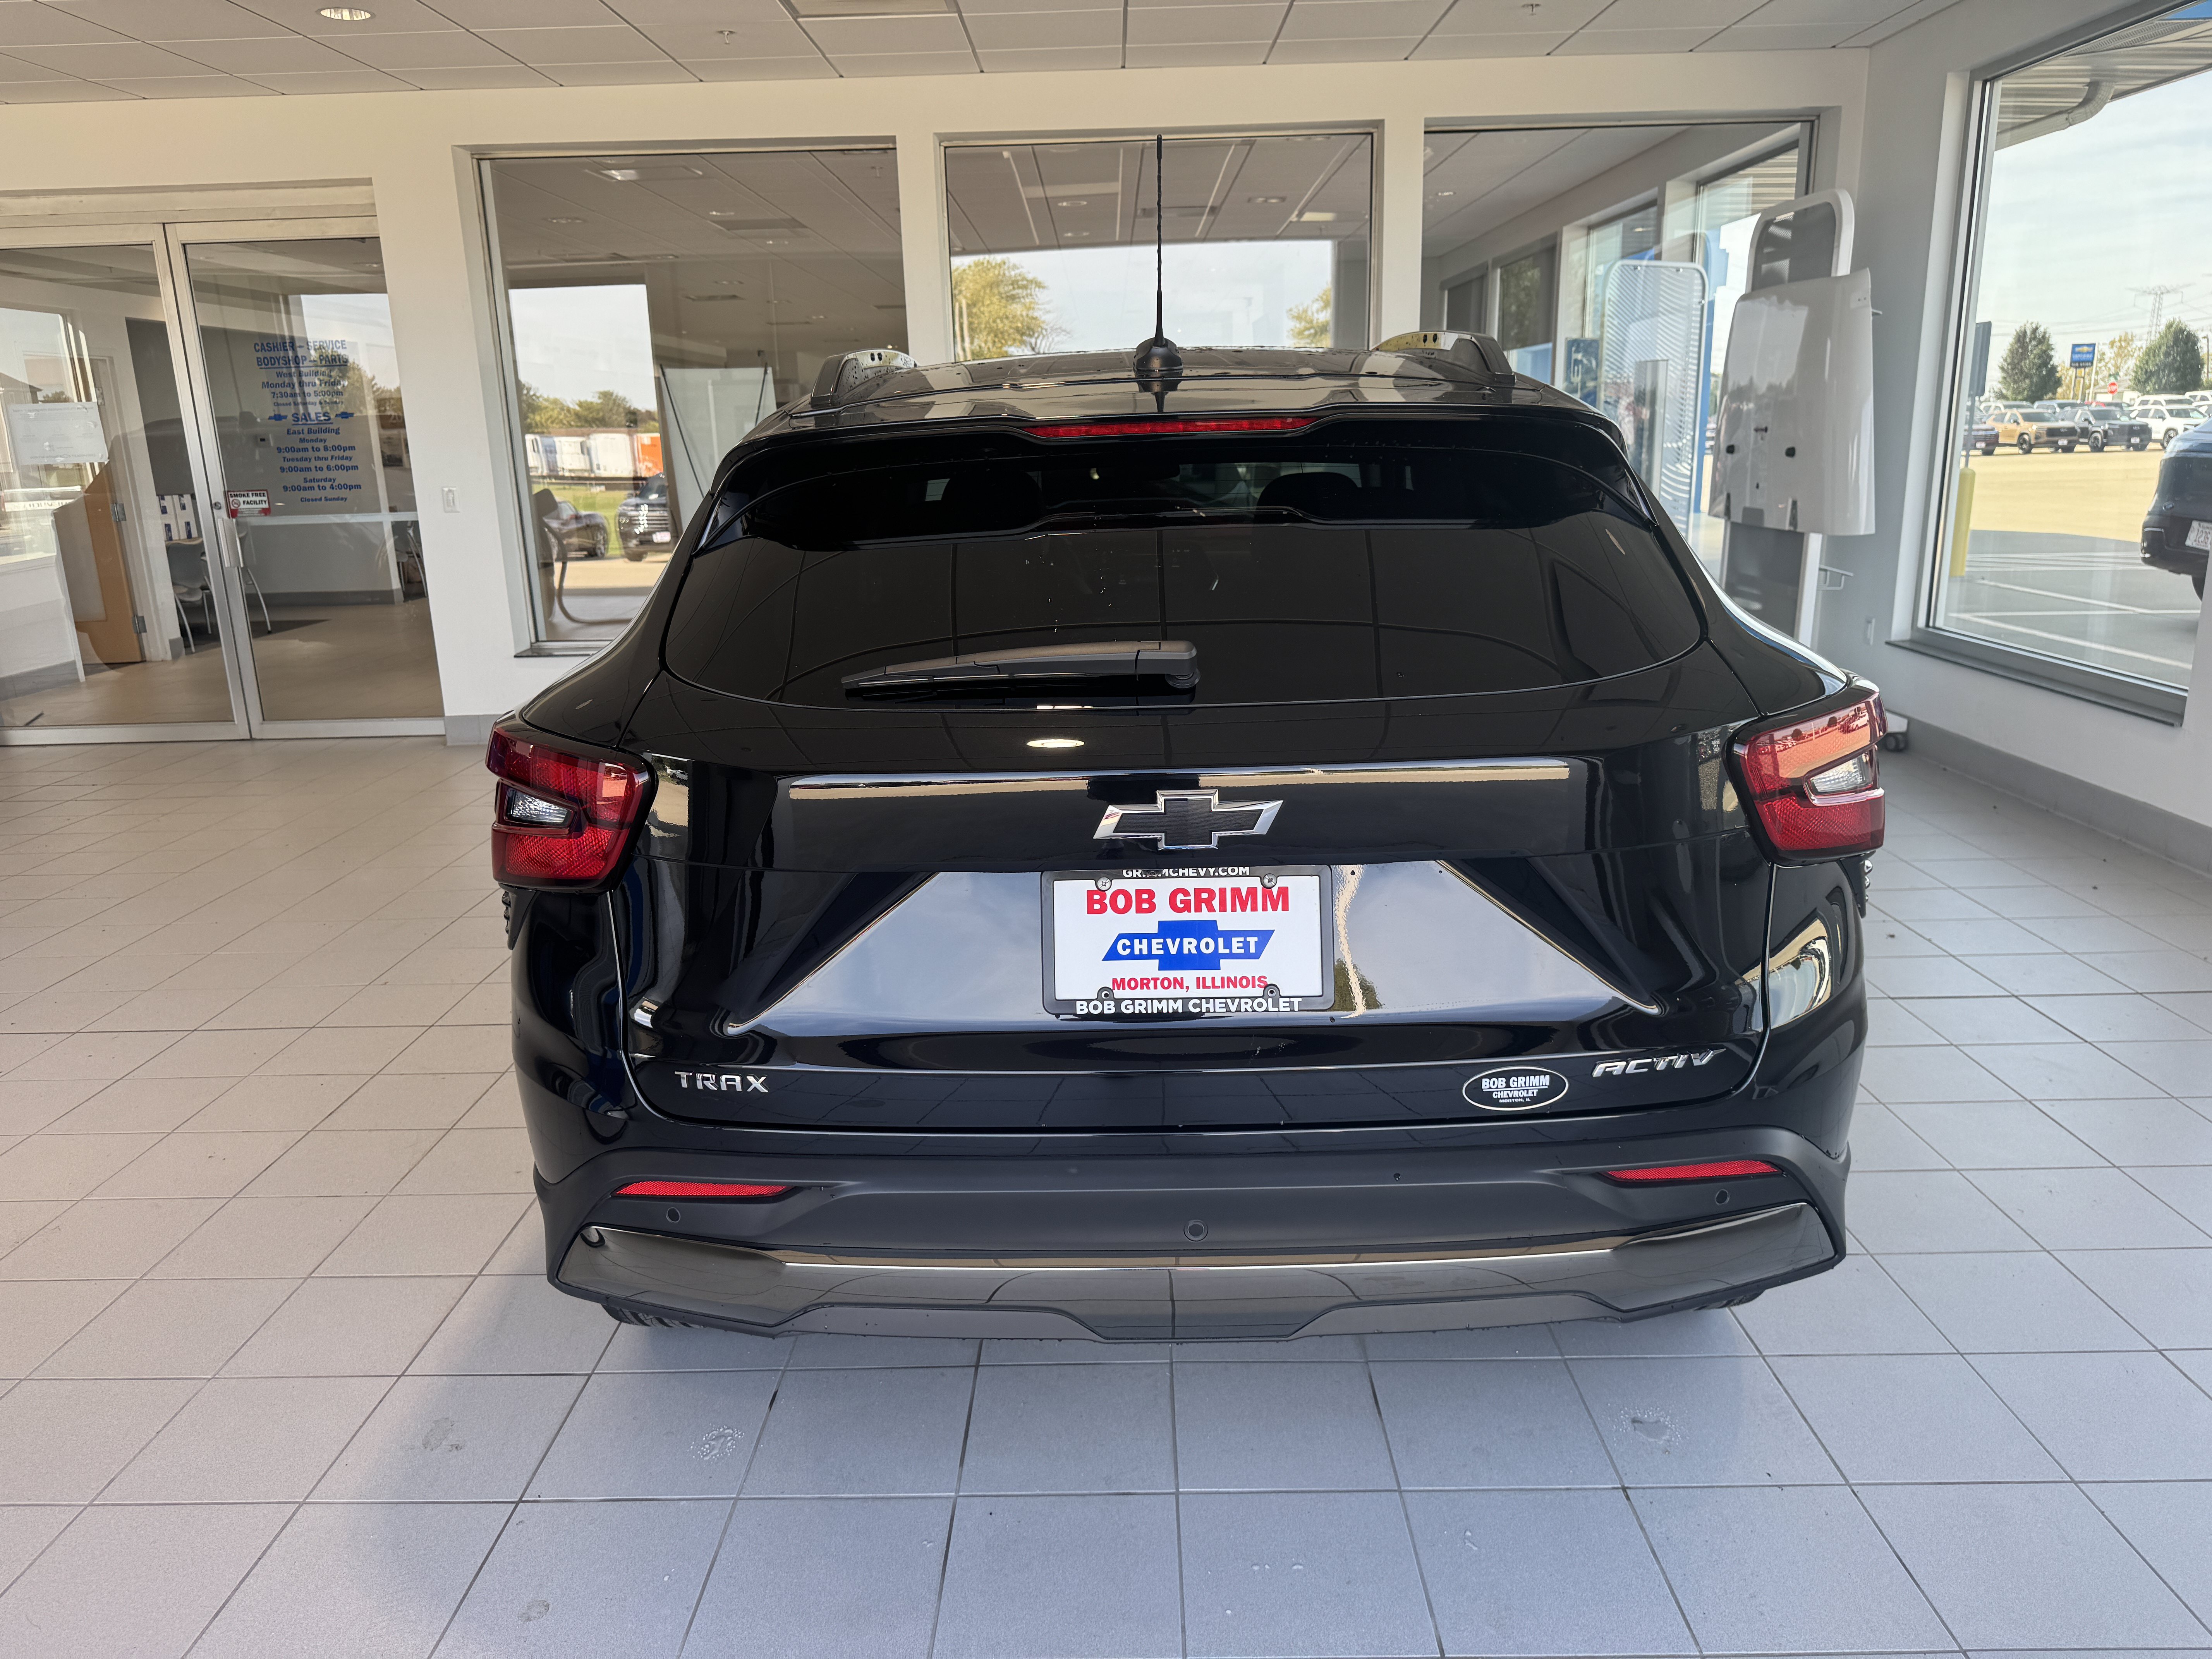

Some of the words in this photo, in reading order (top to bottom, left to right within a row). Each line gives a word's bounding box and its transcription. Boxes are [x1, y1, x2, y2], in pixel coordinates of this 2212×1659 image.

[254, 341, 295, 352] CASHIER
[307, 340, 347, 350] SERVICE
[256, 355, 307, 366] BODYSHOP
[319, 354, 348, 364] PARTS
[299, 369, 332, 378] Building
[261, 381, 295, 389] Monday
[314, 390, 343, 398] 5:00pm
[291, 412, 331, 423] SALES
[307, 427, 340, 435] Building
[323, 445, 356, 453] 8:00pm
[329, 483, 362, 491] 4:00pm
[1123, 866, 1250, 878] GRMCHEVY.COM
[1086, 889, 1157, 915] BOB
[1168, 886, 1289, 913] GRIMM
[1117, 937, 1258, 955] CHEVROLET
[1112, 977, 1190, 993] MORTON,
[1195, 975, 1267, 989] ILLINOIS
[1076, 1000, 1116, 1015] BOB
[1120, 999, 1183, 1014] GRIMM
[1188, 998, 1302, 1013] CHEVROLET
[1591, 1048, 1726, 1077] ACTIV
[674, 1071, 769, 1093] TRAX
[1482, 1077, 1506, 1089] BOB
[1509, 1075, 1550, 1088] GRIMM
[1492, 1089, 1538, 1099] CHEVROLET
